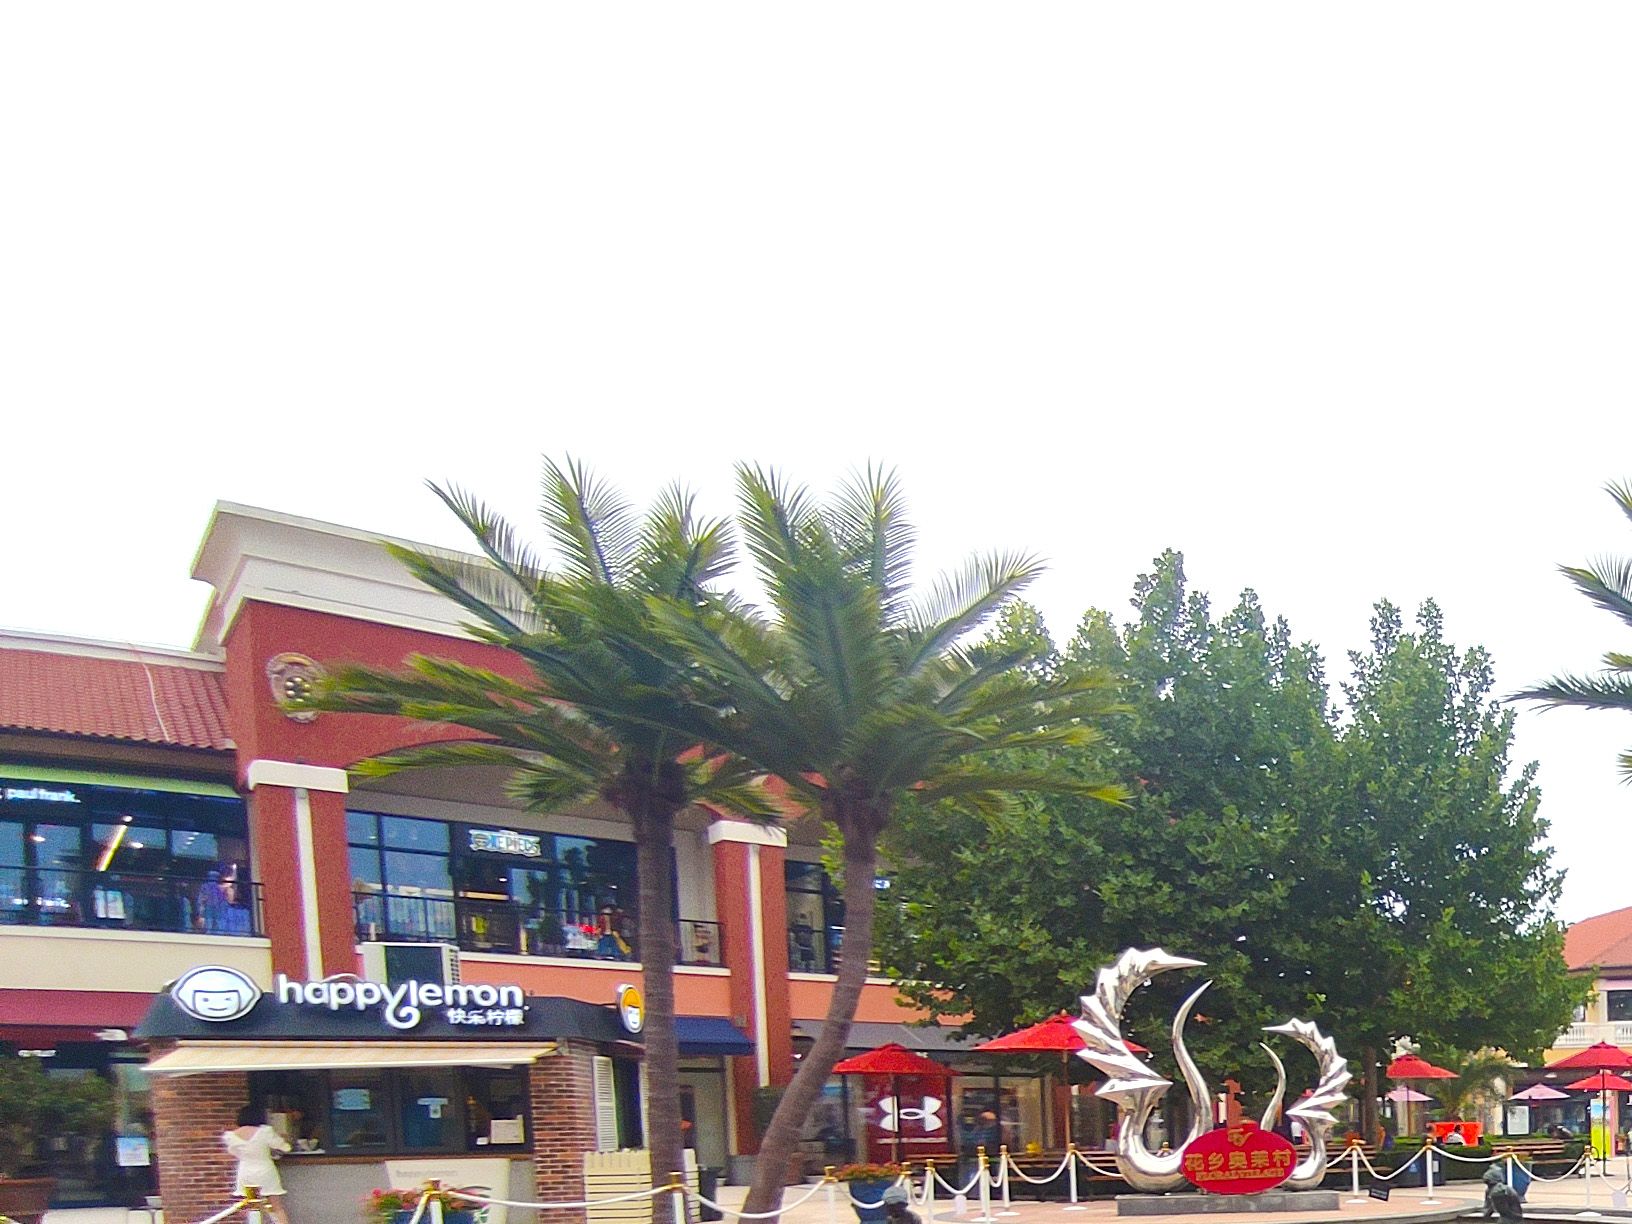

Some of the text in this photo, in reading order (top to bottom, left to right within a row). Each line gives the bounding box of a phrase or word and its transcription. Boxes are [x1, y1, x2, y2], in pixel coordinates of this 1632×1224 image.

[447, 1008, 525, 1025] 快乐柠檬
[1185, 1149, 1292, 1172] 花乡奥莱村
